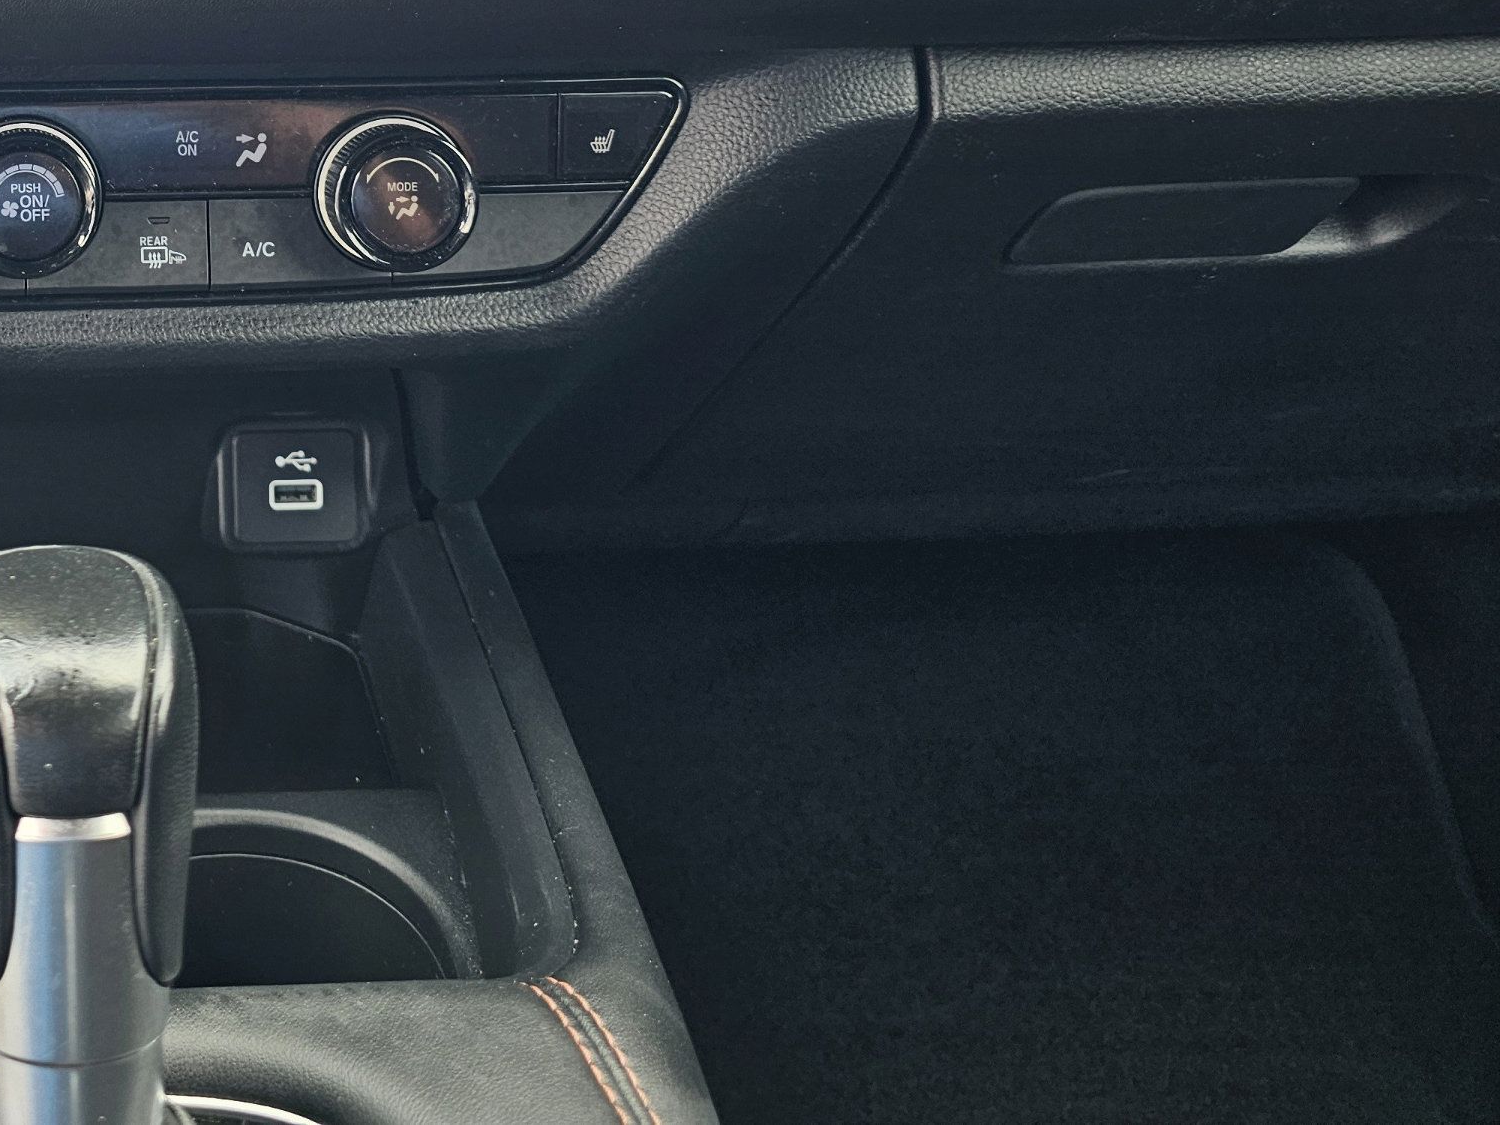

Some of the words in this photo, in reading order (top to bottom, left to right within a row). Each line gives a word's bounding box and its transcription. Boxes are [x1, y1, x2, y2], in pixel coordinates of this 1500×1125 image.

[176, 130, 199, 143] A/C
[178, 144, 197, 156] ON
[11, 183, 40, 193] PUSH
[387, 182, 417, 191] MODE
[20, 209, 50, 221] OFF
[140, 236, 168, 246] REAR
[242, 242, 274, 257] A/C
